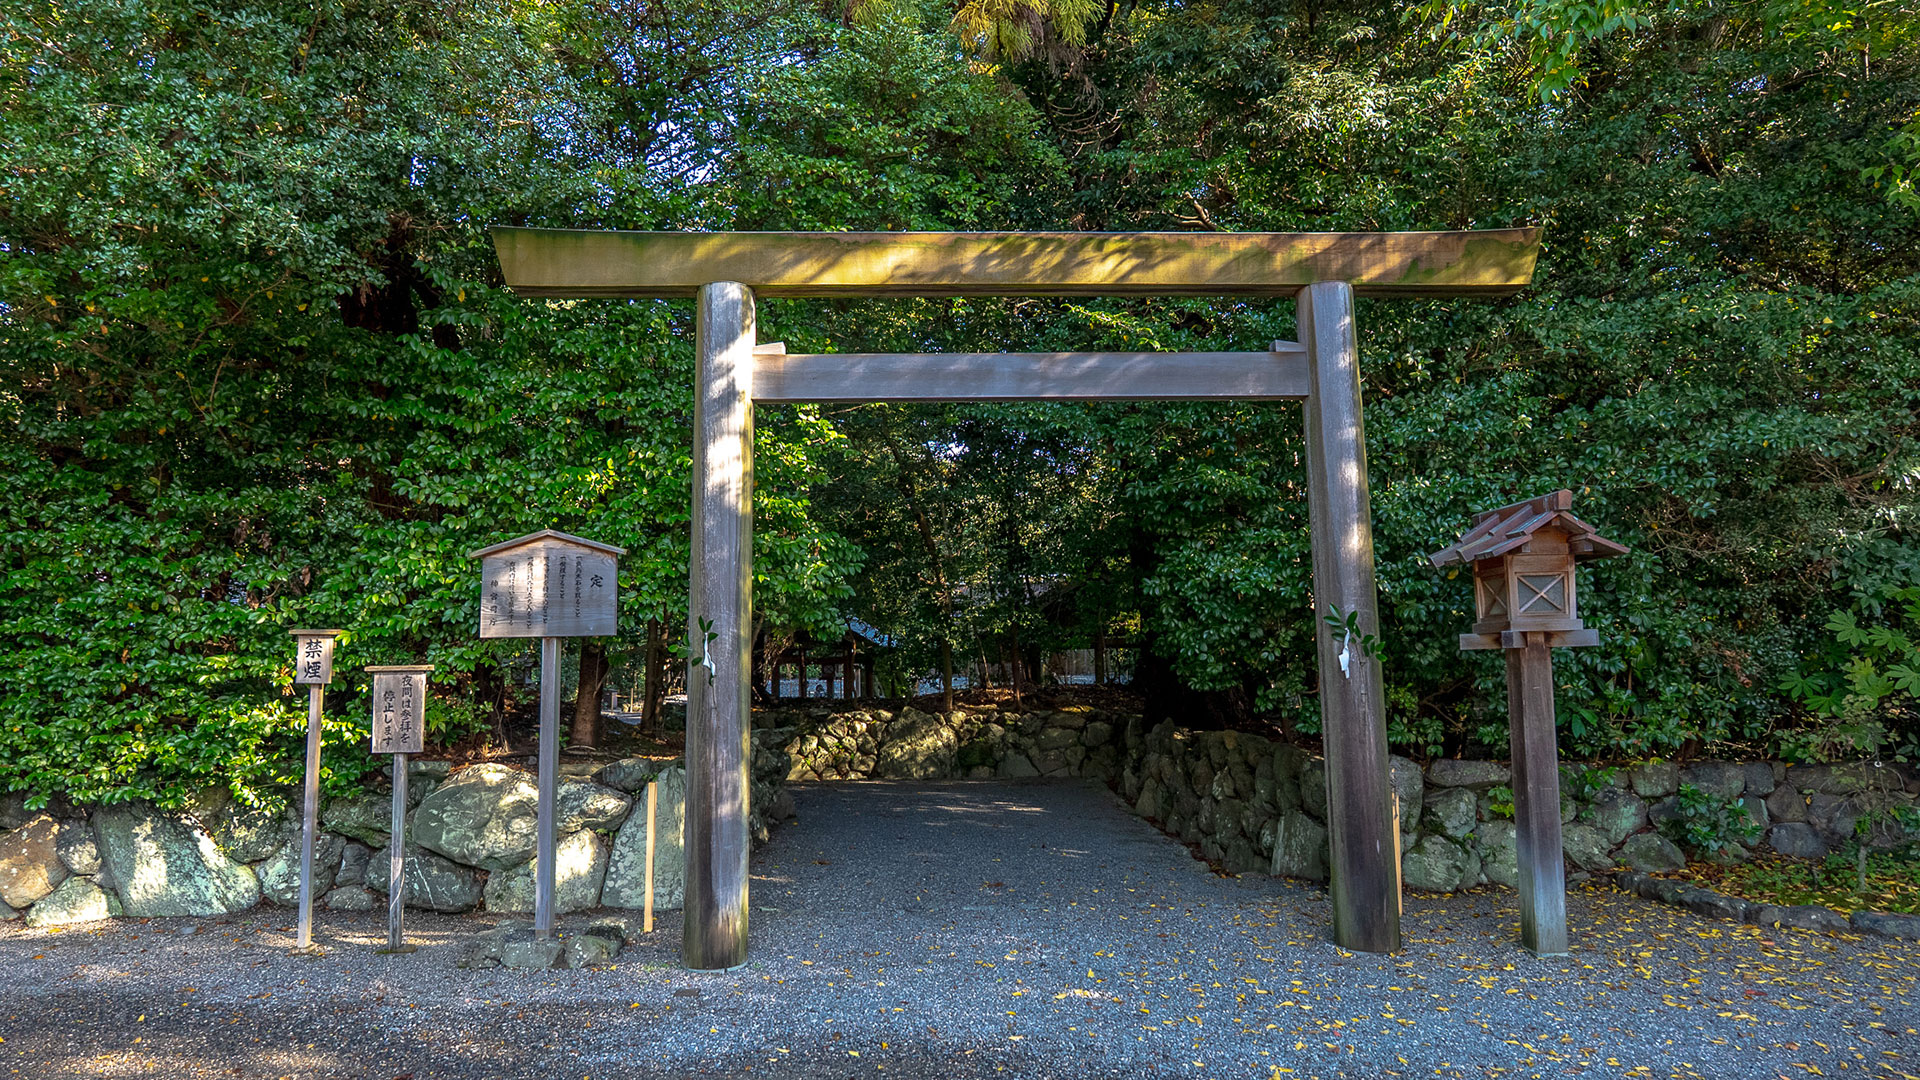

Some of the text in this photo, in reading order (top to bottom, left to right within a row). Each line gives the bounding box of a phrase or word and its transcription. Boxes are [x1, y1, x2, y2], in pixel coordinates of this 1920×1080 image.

[488, 579, 499, 627] 神宮司庁
[590, 574, 603, 588] 定
[304, 639, 322, 679] 禁煙
[383, 690, 395, 747] 停止します
[400, 675, 413, 744] 夜間は参拝を
